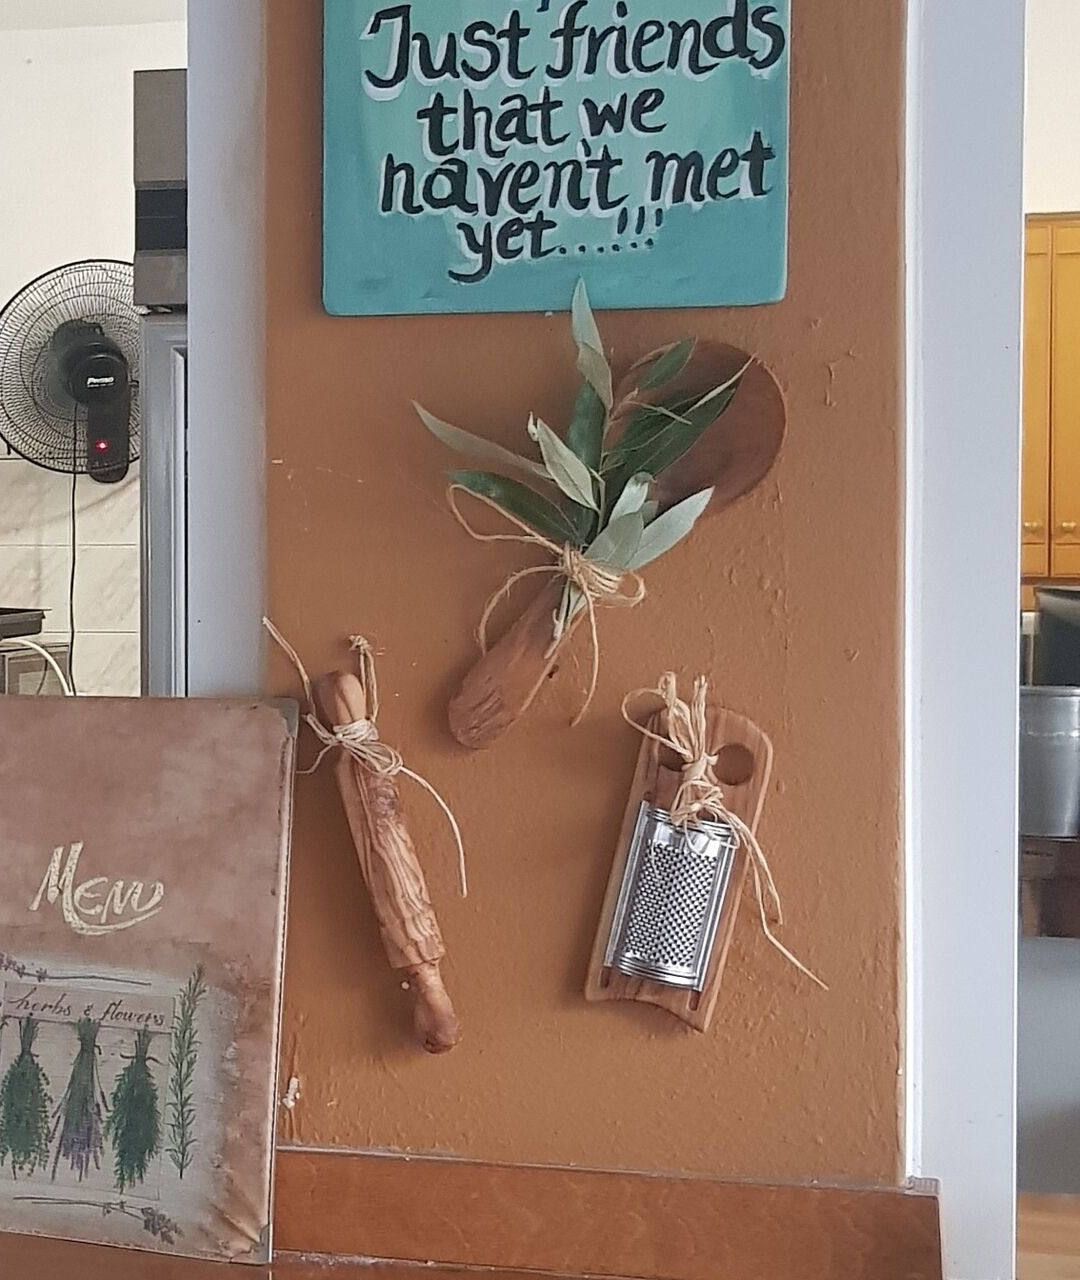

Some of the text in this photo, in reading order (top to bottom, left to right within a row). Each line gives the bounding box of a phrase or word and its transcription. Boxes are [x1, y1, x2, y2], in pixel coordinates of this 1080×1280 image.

[365, 3, 534, 88] Just
[417, 87, 665, 158] that we
[644, 131, 776, 204] met
